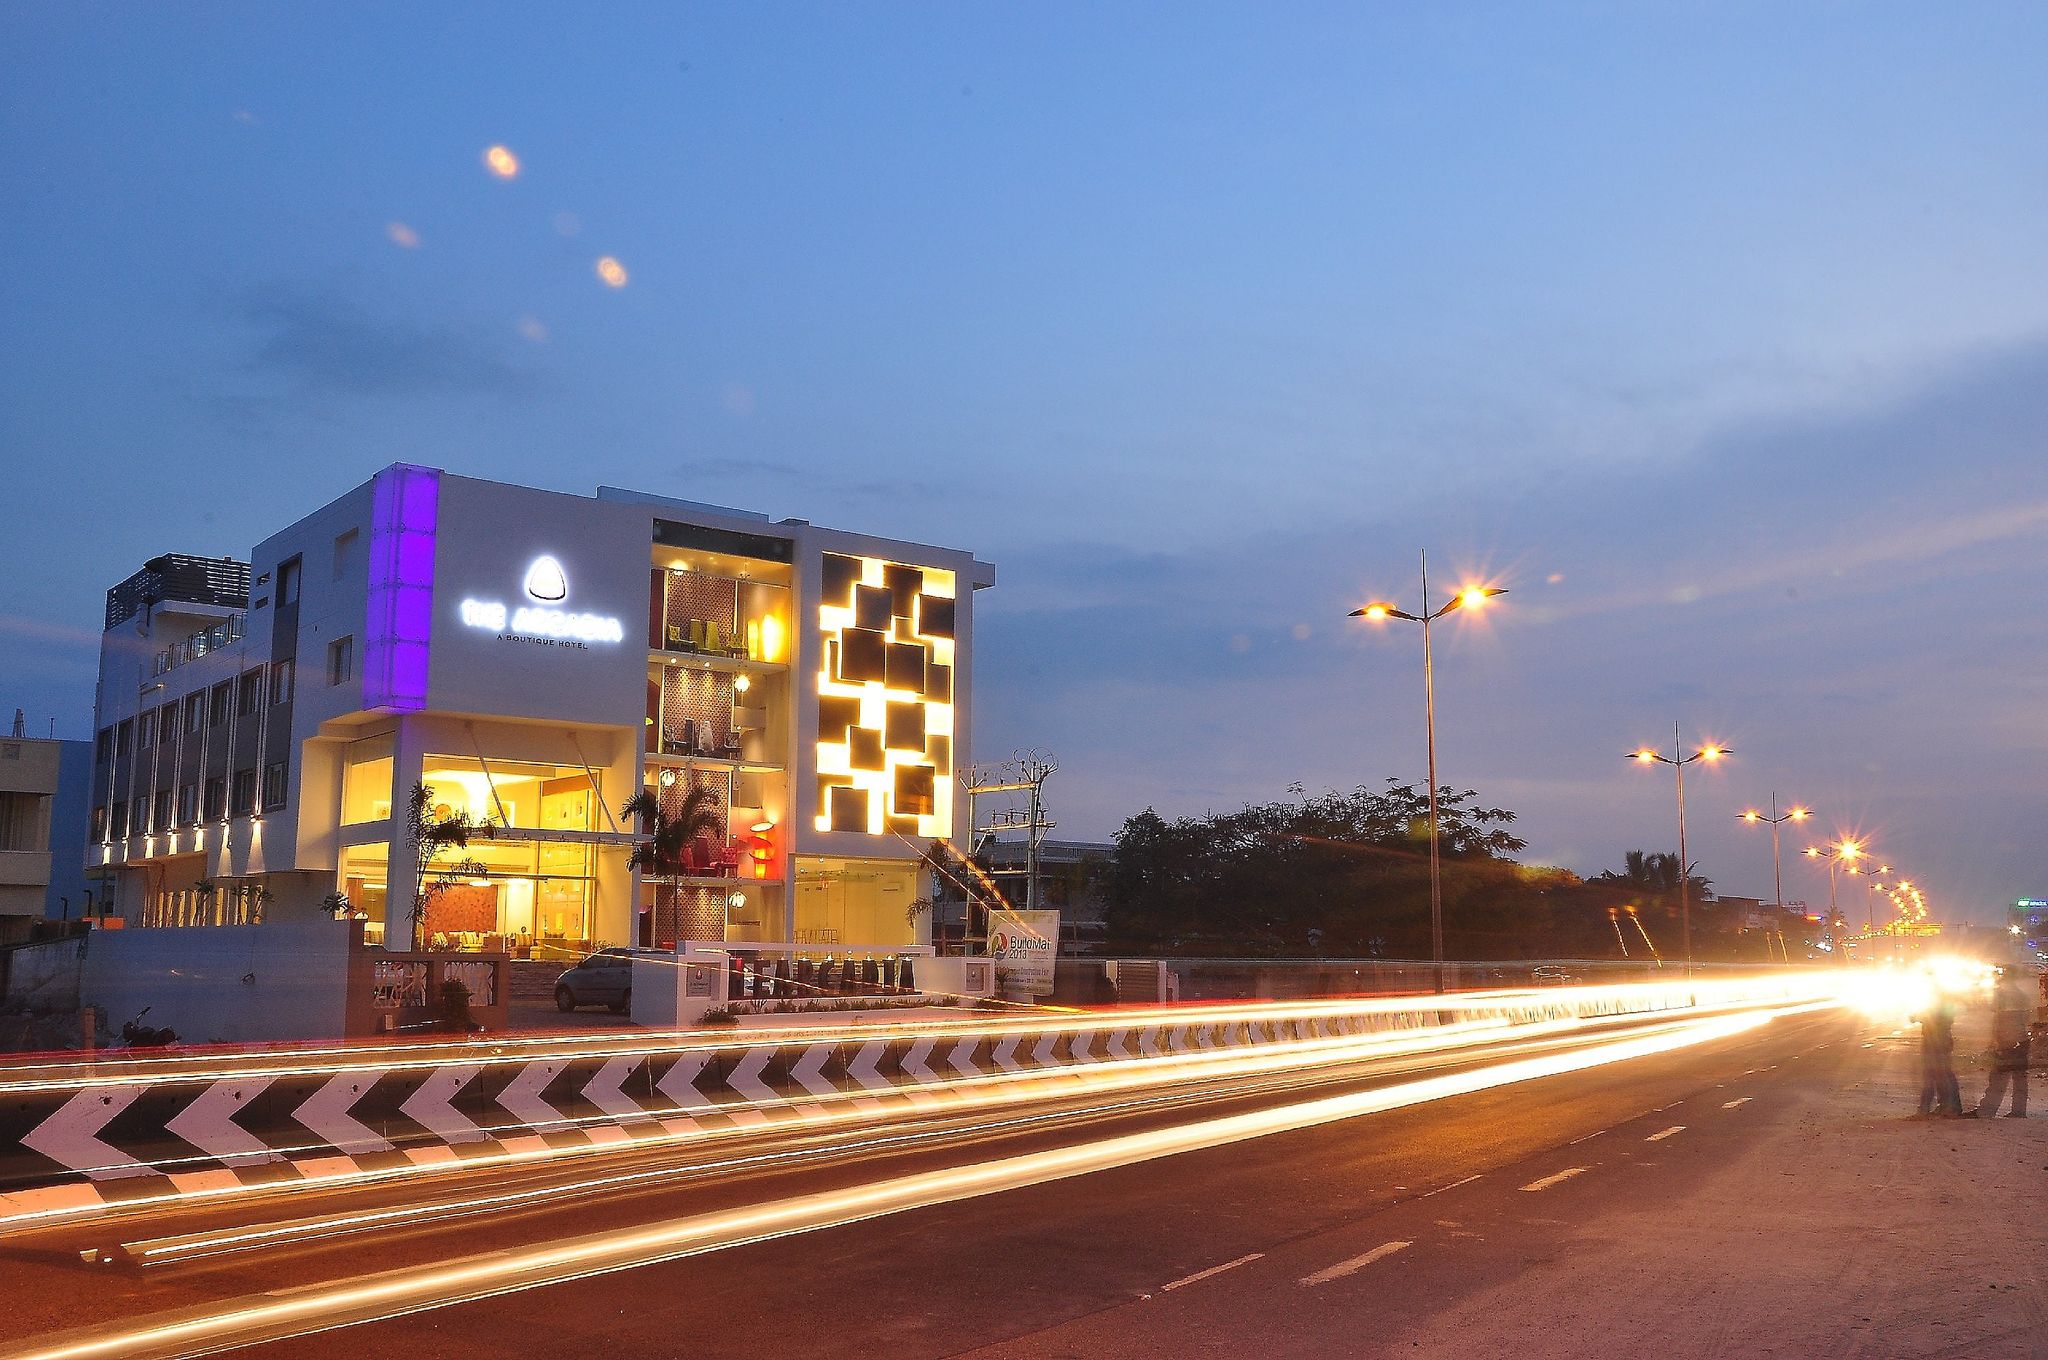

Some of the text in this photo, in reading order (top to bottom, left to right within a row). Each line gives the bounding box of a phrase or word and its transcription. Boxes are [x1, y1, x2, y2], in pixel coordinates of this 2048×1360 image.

[496, 633, 588, 650] A BOUTIQUE HOTEL
[1010, 935, 1050, 951] BuildMat
[1009, 949, 1027, 960] 2013
